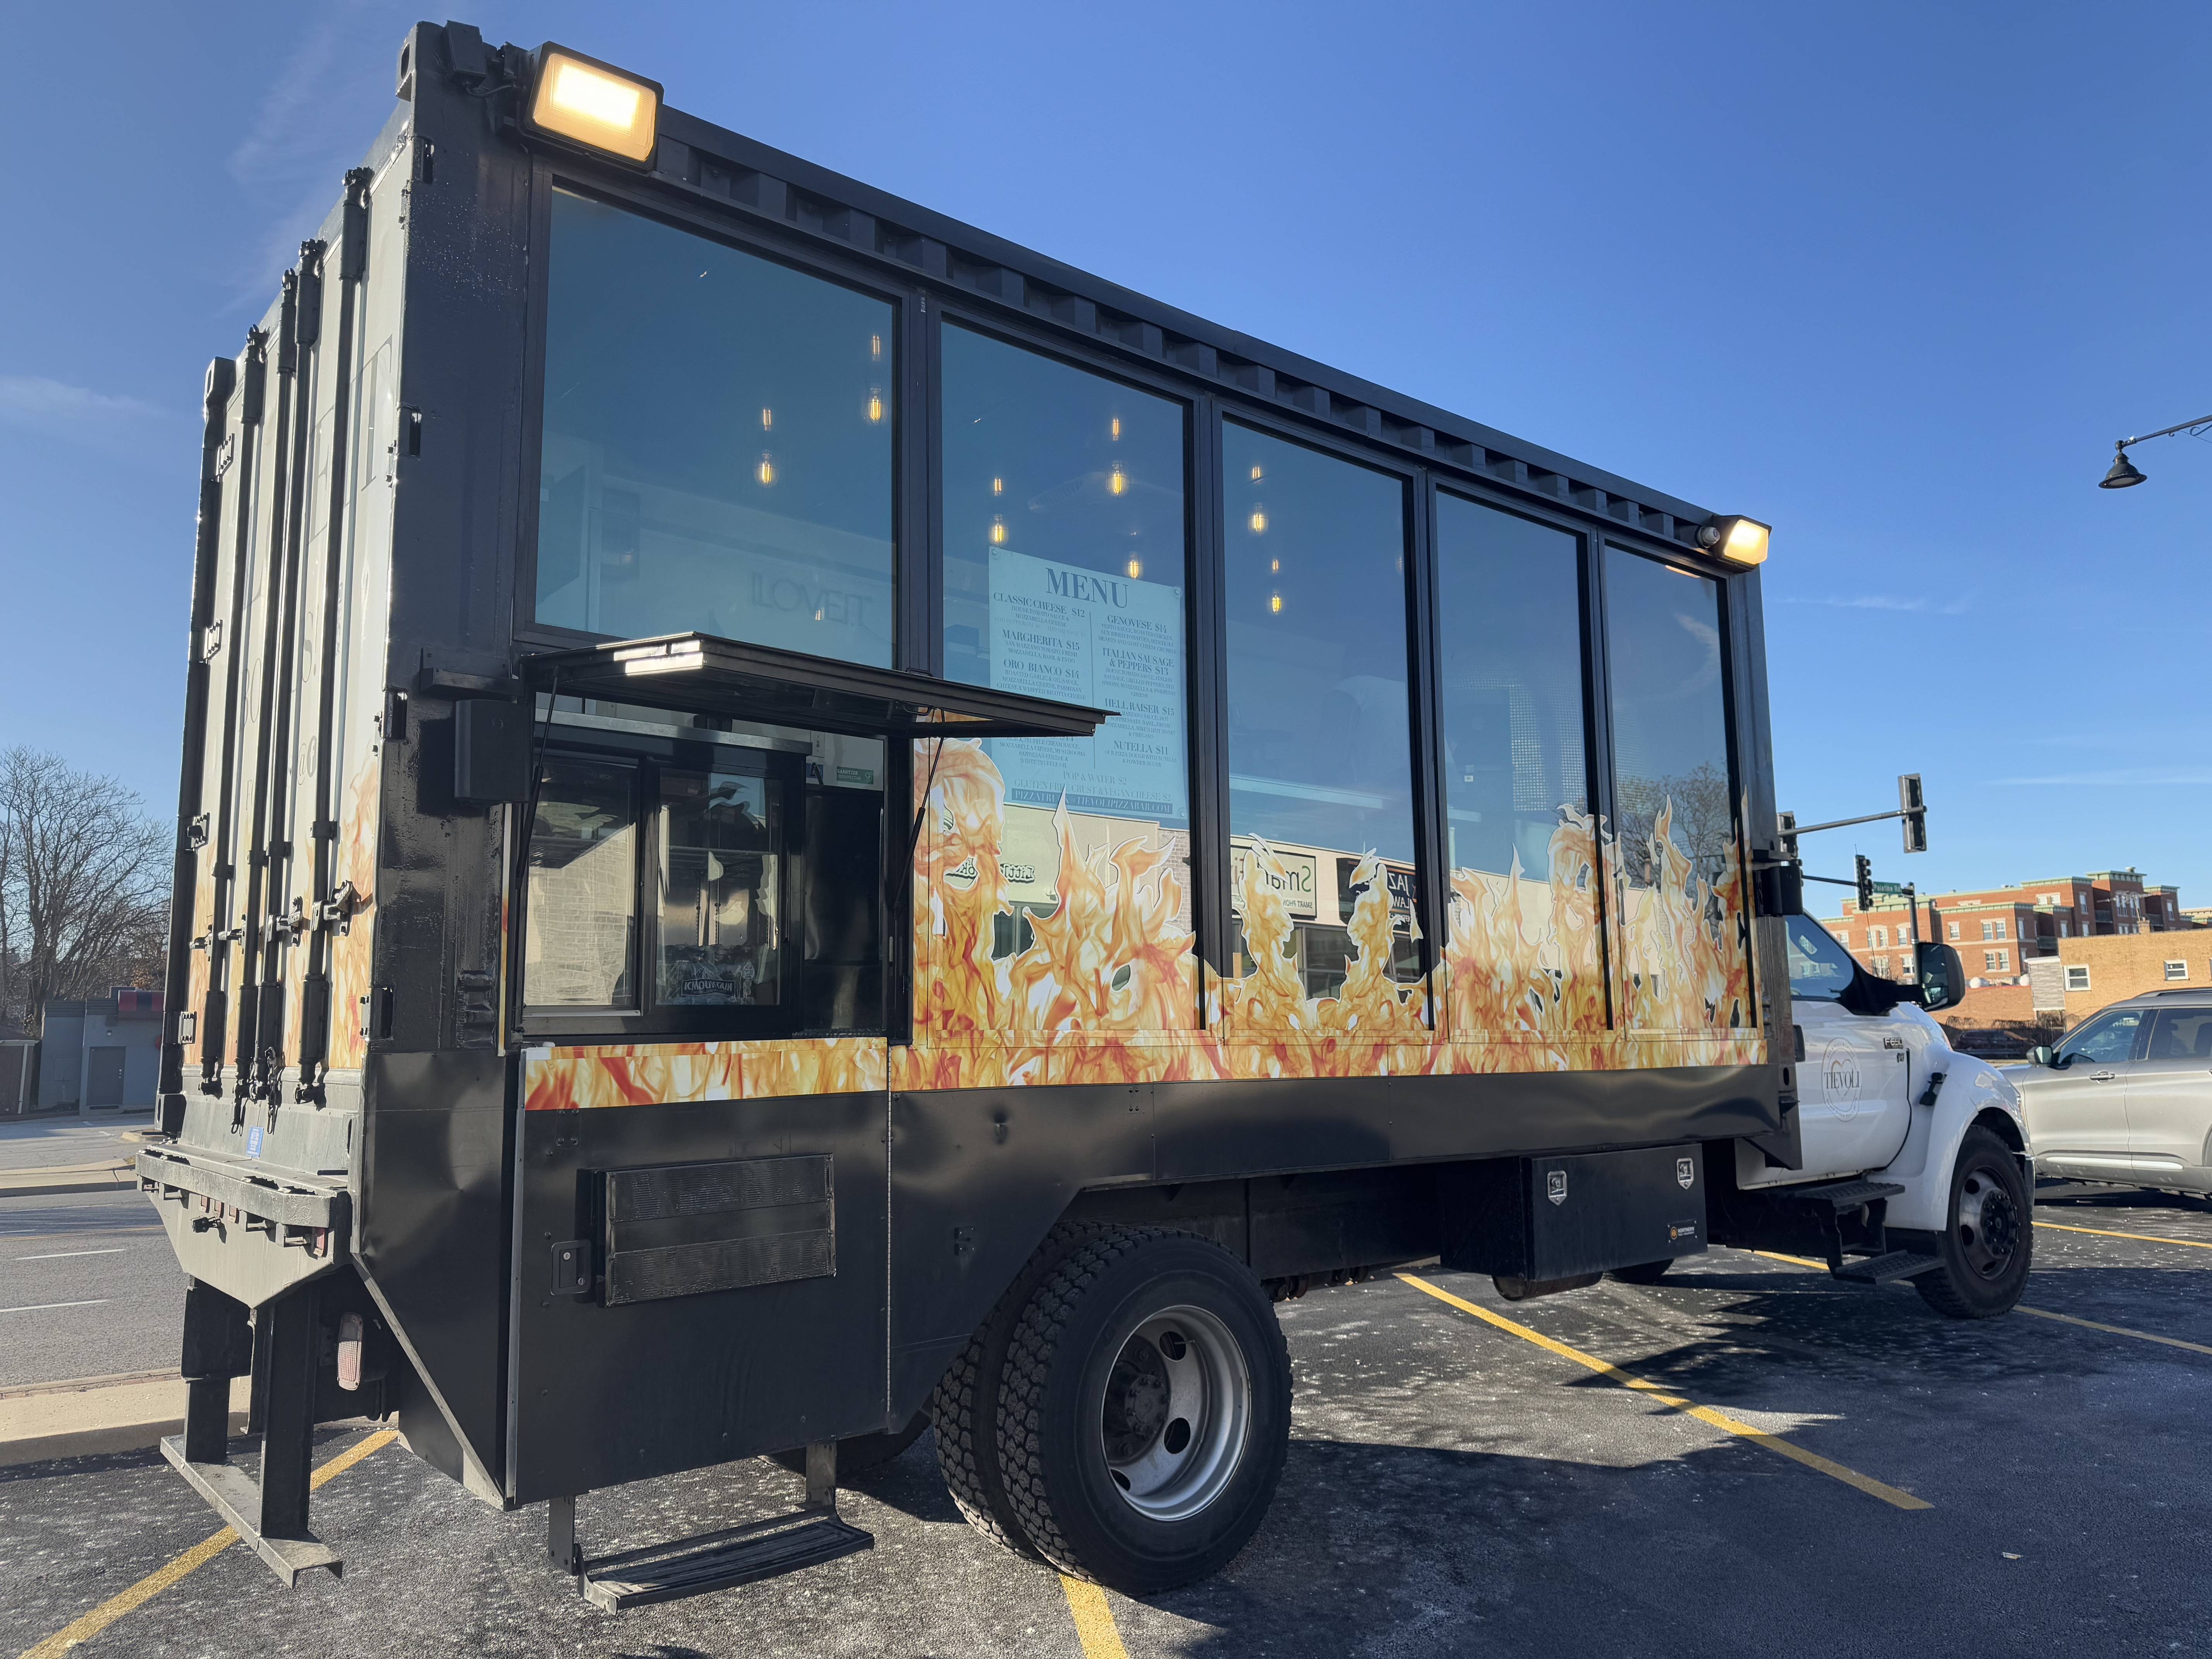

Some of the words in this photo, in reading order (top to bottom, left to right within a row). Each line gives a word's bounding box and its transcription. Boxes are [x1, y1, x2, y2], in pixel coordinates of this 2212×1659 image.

[1045, 567, 1128, 608] MENU
[994, 592, 1032, 607] CLASSIC
[1034, 600, 1066, 614] CHEESE
[1016, 613, 1047, 623] MOZZARELLA
[1108, 615, 1152, 630] GENOVESE
[1003, 629, 1063, 648] MARGHERITA
[1133, 629, 1153, 637] ROASTED
[1103, 647, 1136, 660] ITALIAN
[1138, 653, 1173, 667] SAUSAGE
[1004, 659, 1024, 670] ORO
[1029, 663, 1061, 676] BIANCO
[1110, 658, 1115, 667] &
[1118, 659, 1152, 673] PEPPERS
[1003, 677, 1034, 685] MOZZARELLA
[1105, 698, 1128, 710] HELL
[1130, 702, 1159, 714] RAISER
[1114, 740, 1152, 753] NUTELLA
[1064, 771, 1079, 780] POP
[1087, 774, 1115, 784] WATER
[1015, 779, 1048, 789] GLUTEN
[1072, 784, 1097, 794] CRUST
[1104, 788, 1130, 797] VEGAN
[1132, 791, 1160, 800] CHEESE
[1015, 790, 1170, 812] PIZZATRU@TIEVOLIPIZZABAR.COM
[1824, 1068, 1859, 1089] TIEVOLI
